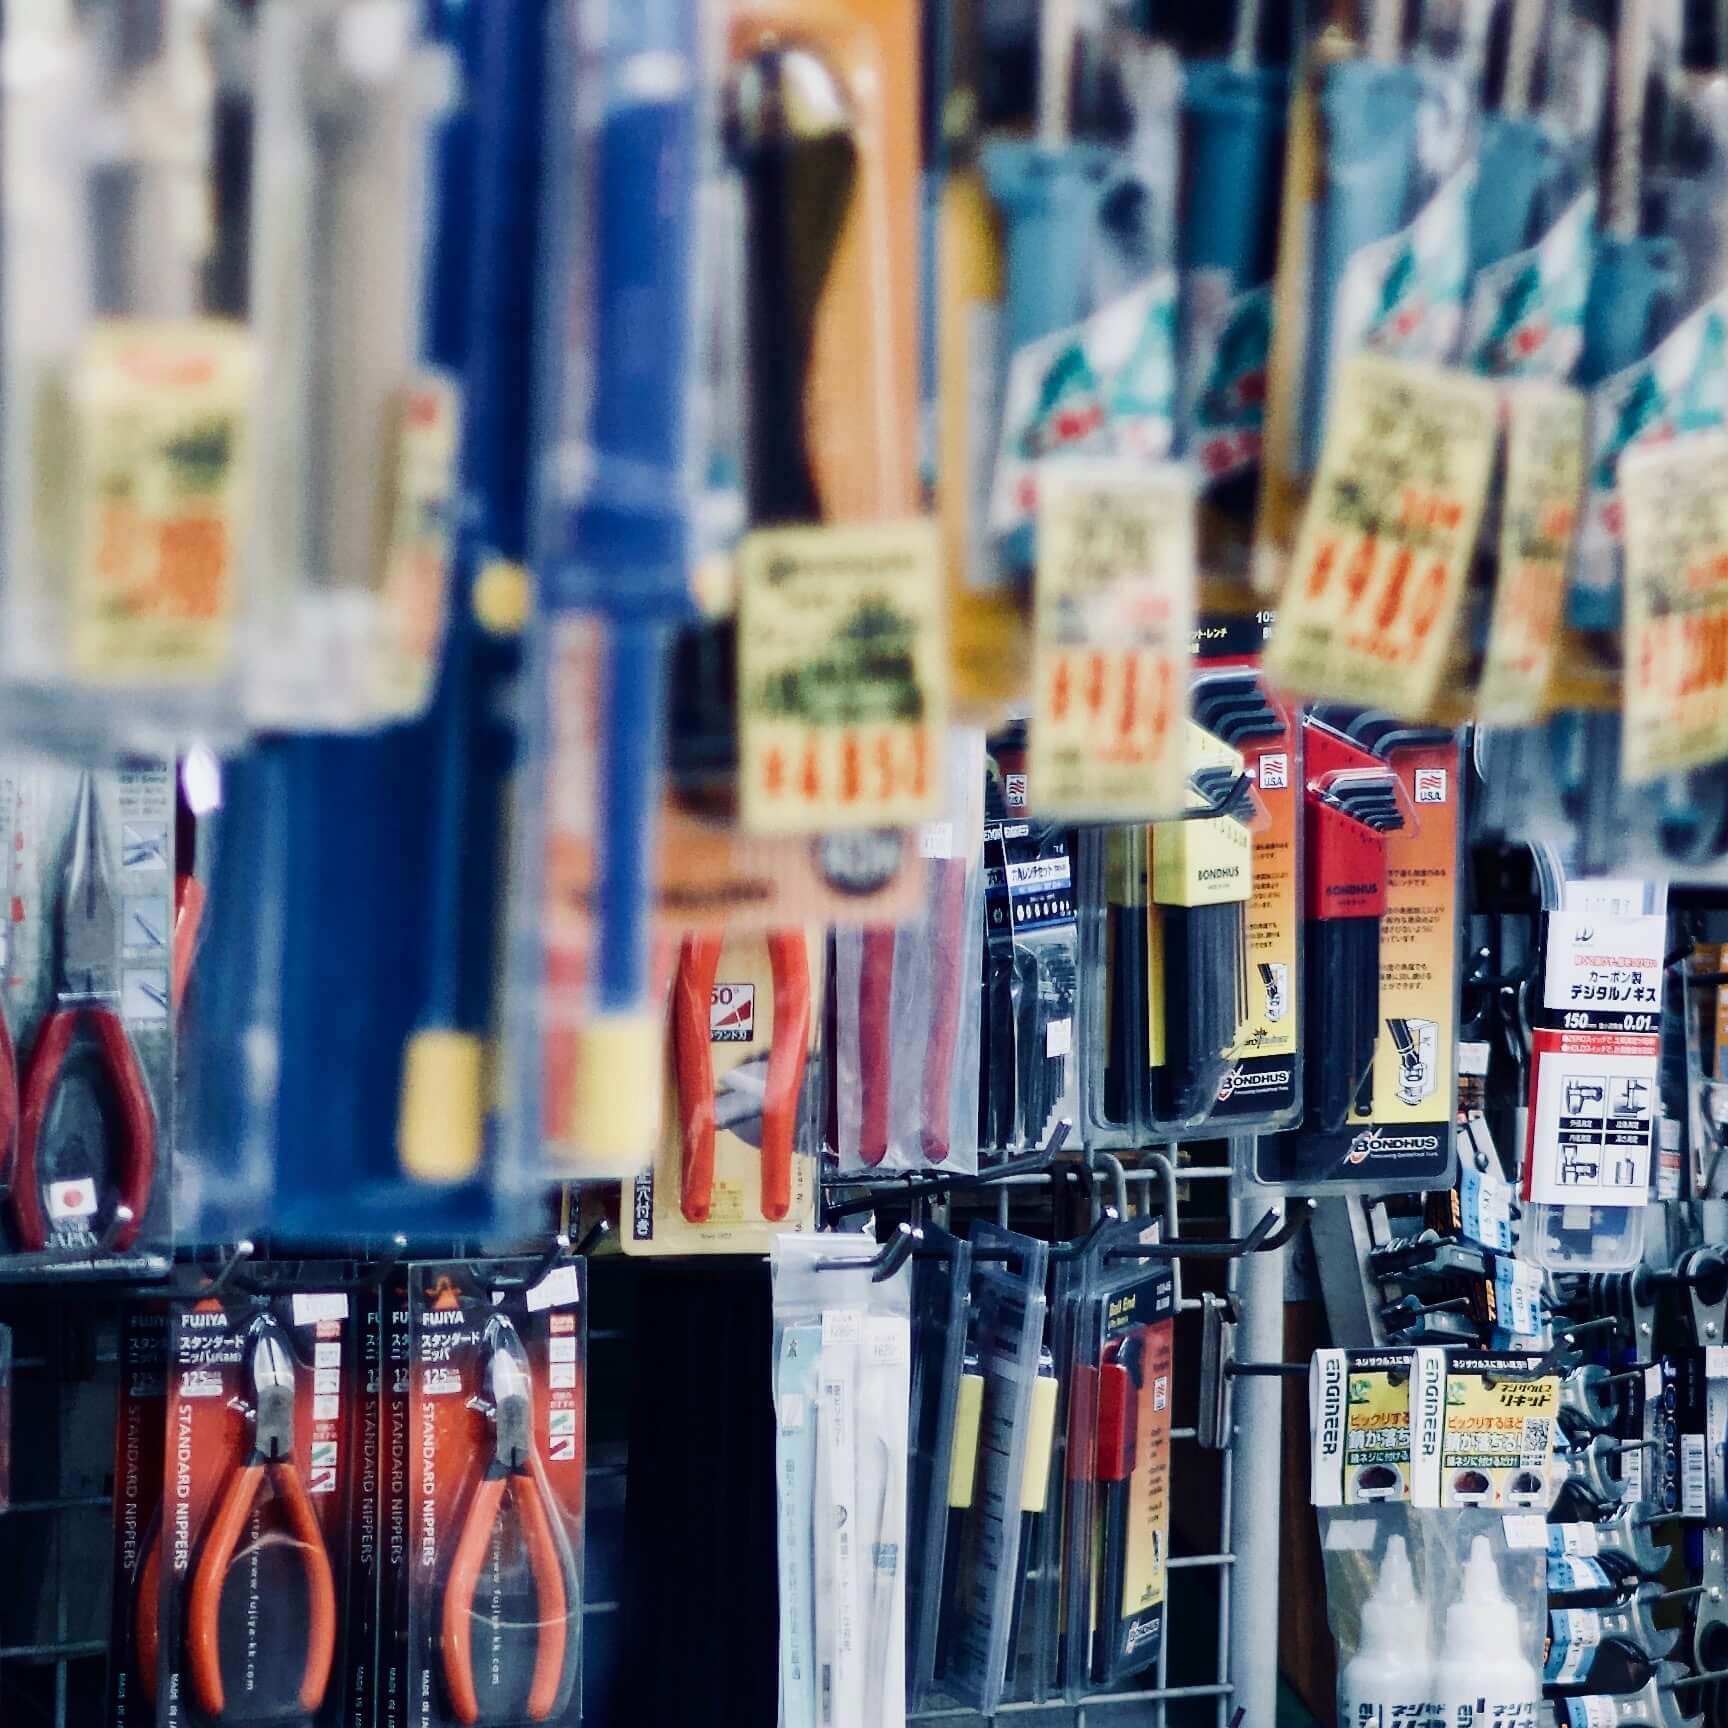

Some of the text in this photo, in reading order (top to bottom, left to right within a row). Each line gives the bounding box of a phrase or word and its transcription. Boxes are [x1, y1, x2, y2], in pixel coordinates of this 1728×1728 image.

[1197, 866, 1240, 882] BONDHUS
[1326, 883, 1378, 897] BONDHUS
[1589, 971, 1642, 985] カーボン製
[1570, 984, 1656, 1002] デジタルノギス
[1223, 1070, 1290, 1091] BONDHUS
[1354, 1136, 1440, 1153] BONDHUS
[180, 1313, 228, 1328] FUJIYA
[421, 1310, 465, 1325] FUJIYA
[179, 1335, 245, 1350] スタンダード
[421, 1331, 480, 1347] スタンダード
[1322, 1358, 1341, 1456] ENGINEER
[1421, 1359, 1439, 1457] ENGINEER
[1499, 1393, 1553, 1408] リキッド
[173, 1403, 193, 1569] STANDARD NIPPERS
[421, 1402, 436, 1567] STANDARD NIPPERS
